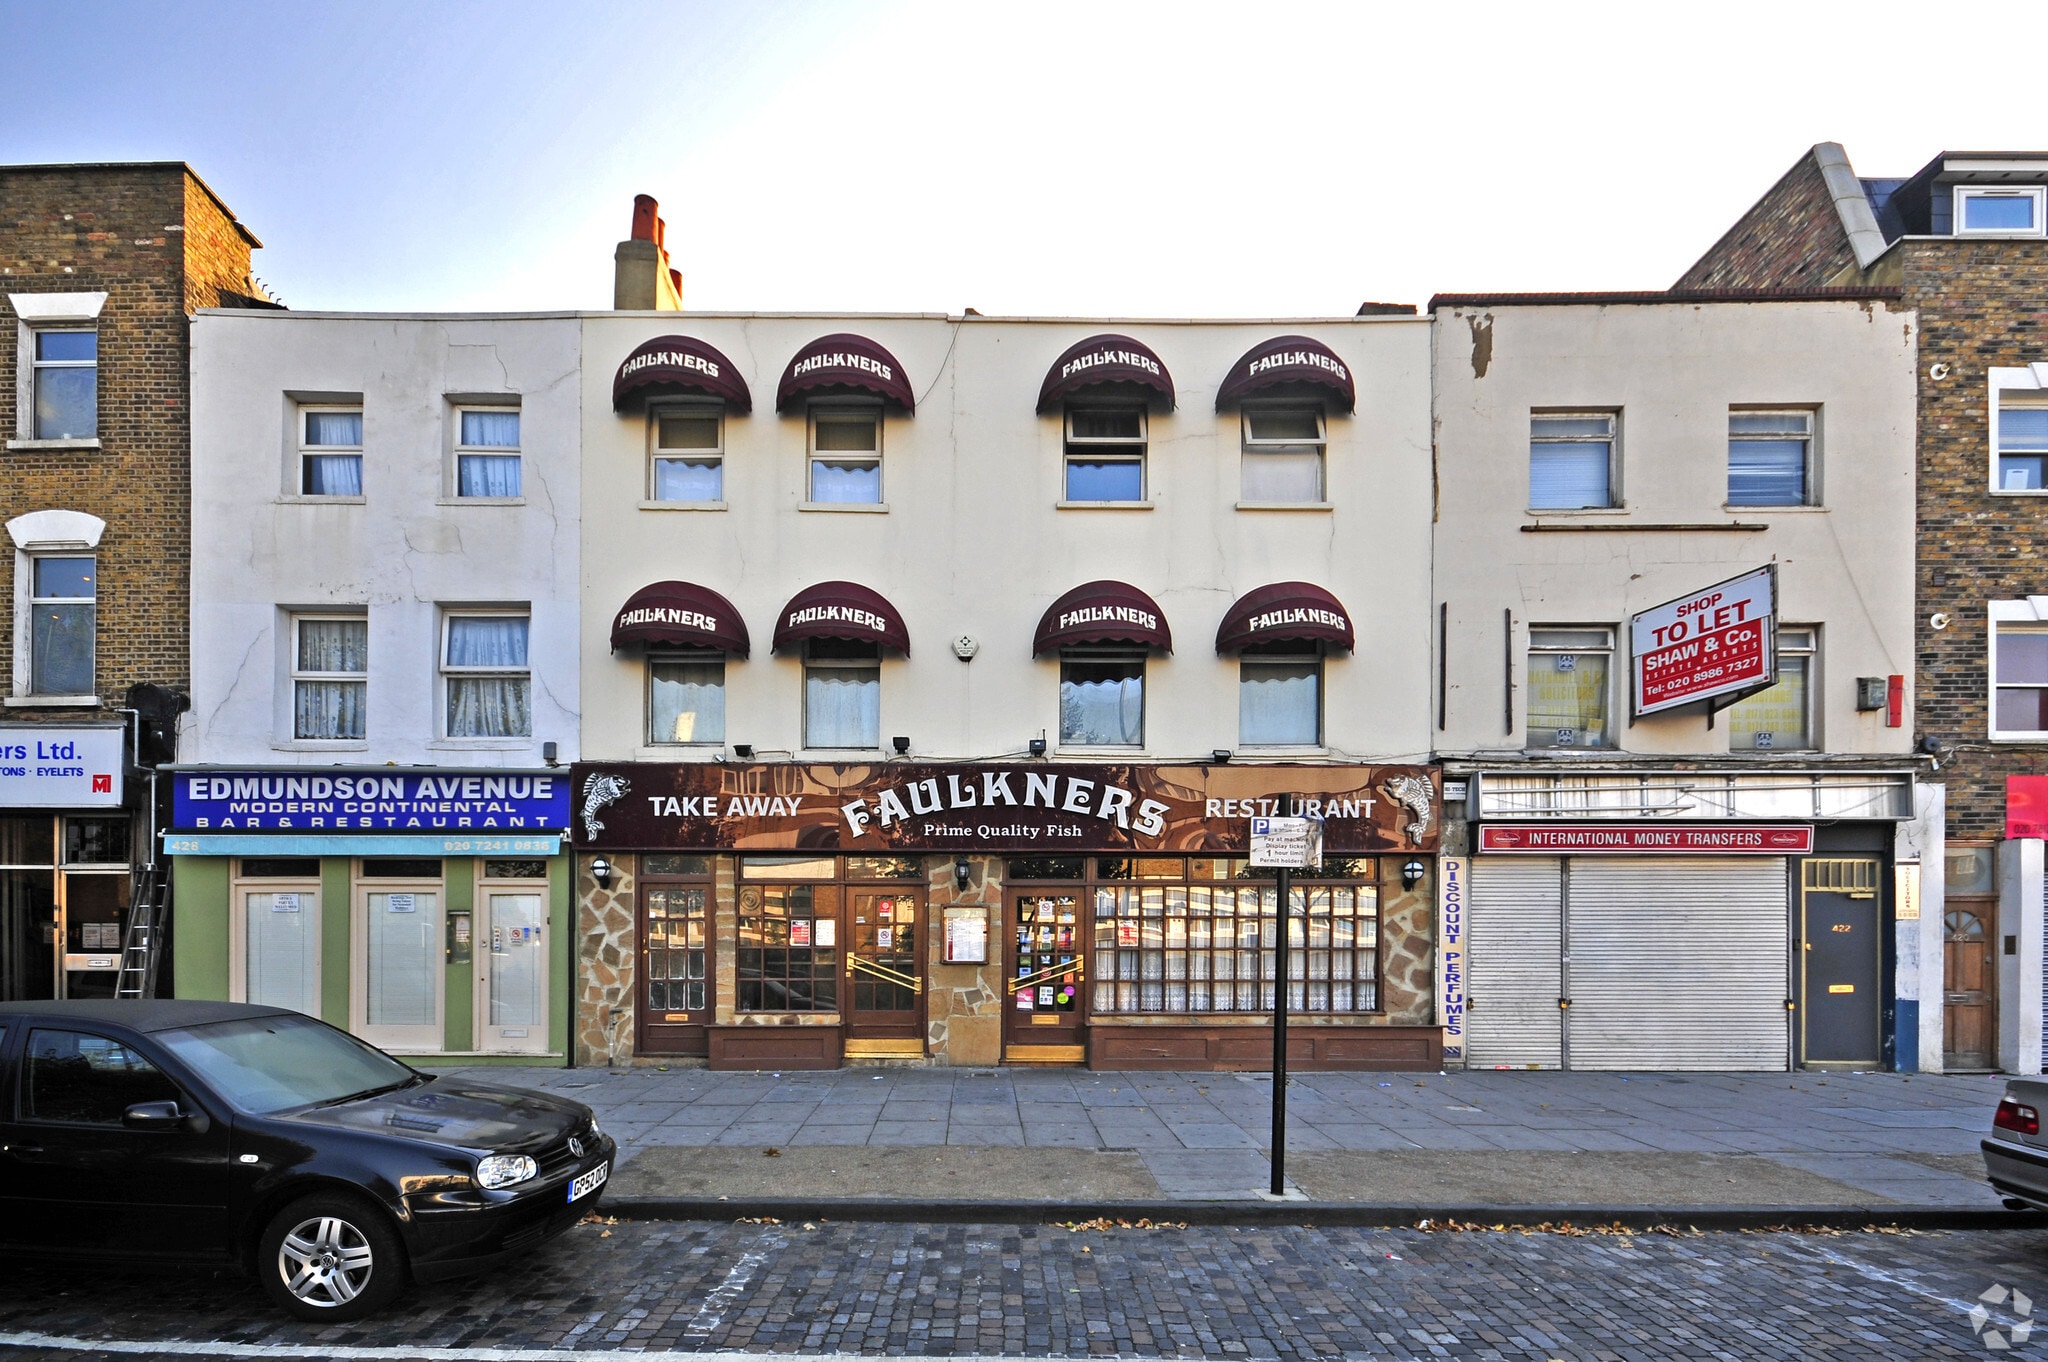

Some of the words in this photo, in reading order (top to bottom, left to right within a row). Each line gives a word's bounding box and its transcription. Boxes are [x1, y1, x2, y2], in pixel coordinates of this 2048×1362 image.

[622, 351, 719, 379] FAULKNERS
[794, 352, 891, 381] FAULKNERS
[1062, 350, 1160, 379] FAULKNERS
[1249, 351, 1346, 381] FAULKNERS
[1677, 593, 1722, 618] SHOP
[619, 606, 716, 632] FAULKNERS
[788, 606, 886, 632] FAULKNERS
[1059, 606, 1156, 631] FAULKNERS
[1249, 608, 1346, 632] FAULKNERS
[1652, 621, 1688, 647] TO
[1698, 599, 1752, 635] LET
[1646, 642, 1699, 671] SHAW
[1704, 637, 1719, 653] &
[1725, 630, 1757, 646] Co.
[1646, 661, 1692, 681] ESTATE
[1702, 642, 1758, 664] AGENTS
[1646, 685, 1665, 696] Tel:
[1667, 676, 1690, 690] 020
[1693, 667, 1723, 683] 8986
[1727, 656, 1759, 673] 7327
[0, 744, 27, 760] rs
[37, 741, 82, 760] Ltd.
[37, 767, 84, 777] EYELETS
[189, 777, 404, 800] EDMUNDSON
[415, 777, 553, 800] AVENUE
[230, 802, 334, 813] MODERN
[344, 802, 517, 813] CONTINENTAL
[648, 796, 718, 817] TAKE
[726, 796, 802, 817] AWAY
[841, 772, 1170, 838] FAULKNERS
[196, 817, 261, 828] BAR
[278, 817, 293, 828] &
[311, 816, 548, 828] RESTAURANT
[924, 824, 973, 837] Prime
[977, 824, 1040, 840] Quality
[1046, 824, 1082, 837] Fish
[1256, 820, 1268, 834] P
[172, 841, 199, 851] 428
[444, 841, 471, 851] 020
[475, 841, 509, 851] 7241
[1529, 832, 1630, 845] INTERNATIONAL
[1634, 832, 1681, 845] MONEY
[1686, 832, 1762, 845] TRANSFERS
[1266, 849, 1272, 857] 1
[1445, 861, 1460, 944] DISCOUNT
[1831, 924, 1851, 933] 422
[1952, 933, 1970, 942] 420
[1445, 952, 1462, 1035] PERFUMES
[574, 1171, 595, 1197] GP52
